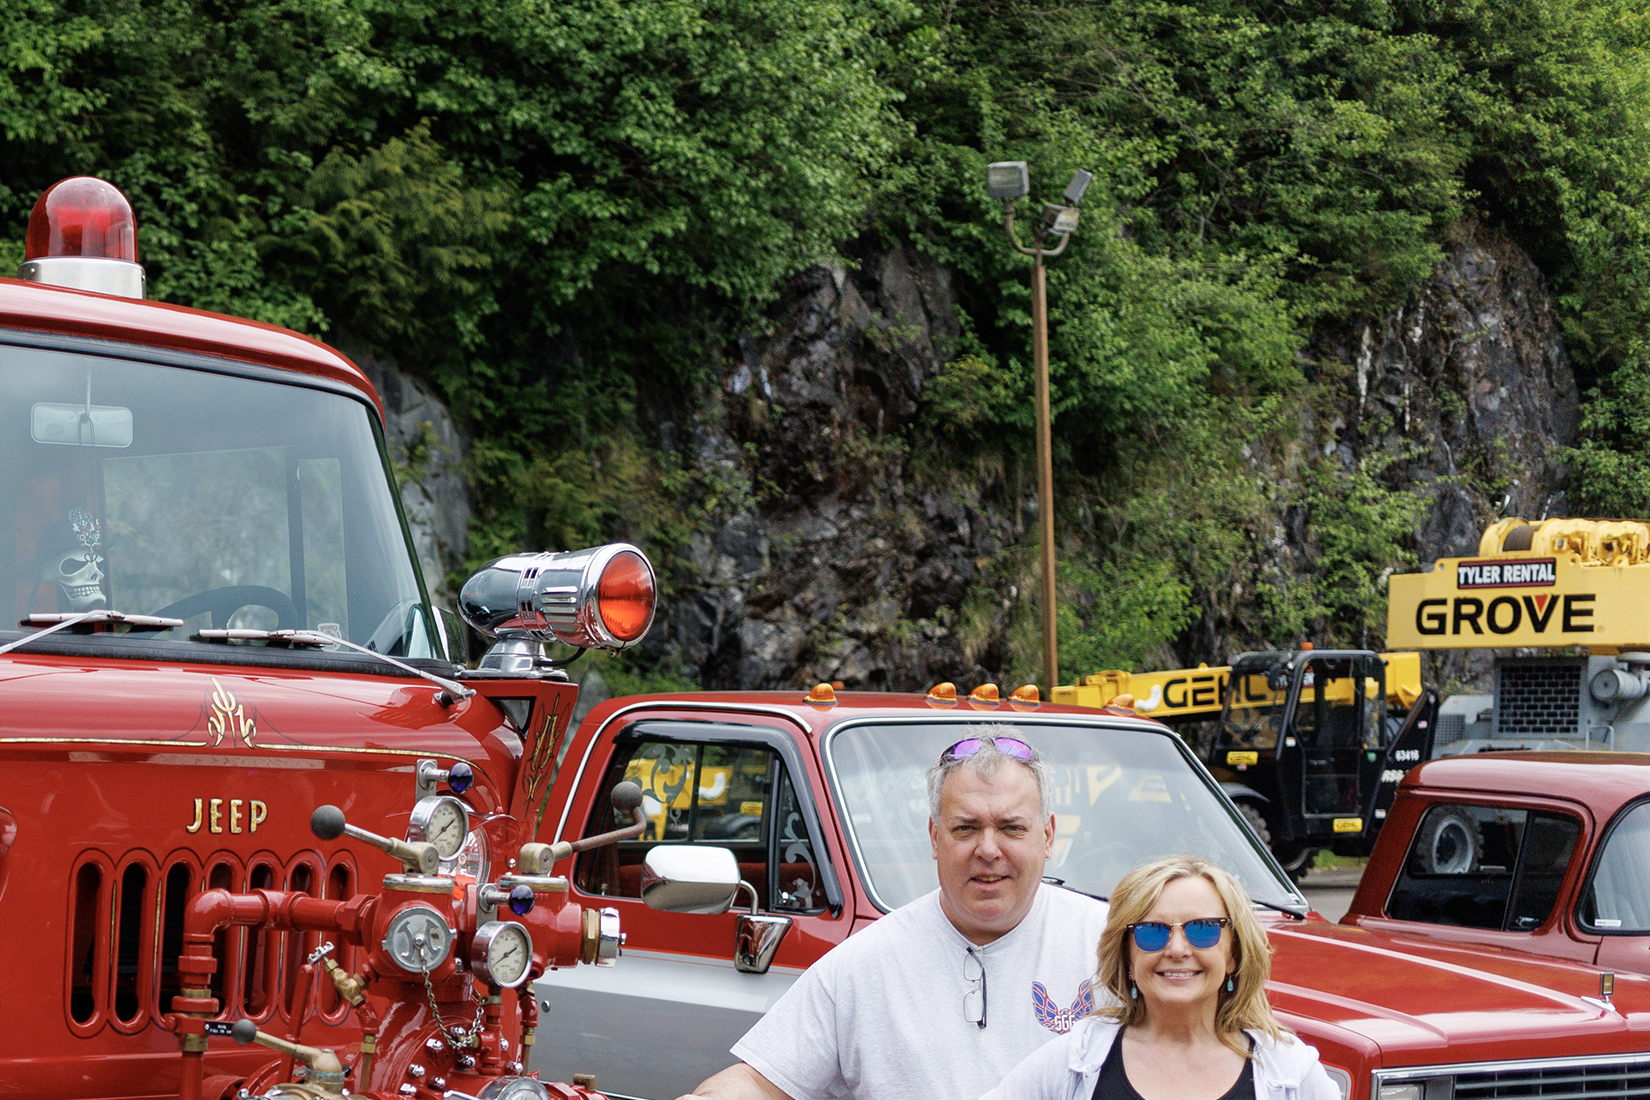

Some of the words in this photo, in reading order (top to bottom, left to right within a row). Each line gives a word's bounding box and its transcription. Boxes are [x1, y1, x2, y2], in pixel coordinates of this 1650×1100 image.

[1458, 565, 1500, 585] TYLER
[1503, 563, 1556, 583] RENTAL
[1416, 594, 1596, 635] GROVE
[185, 797, 268, 834] JEEP
